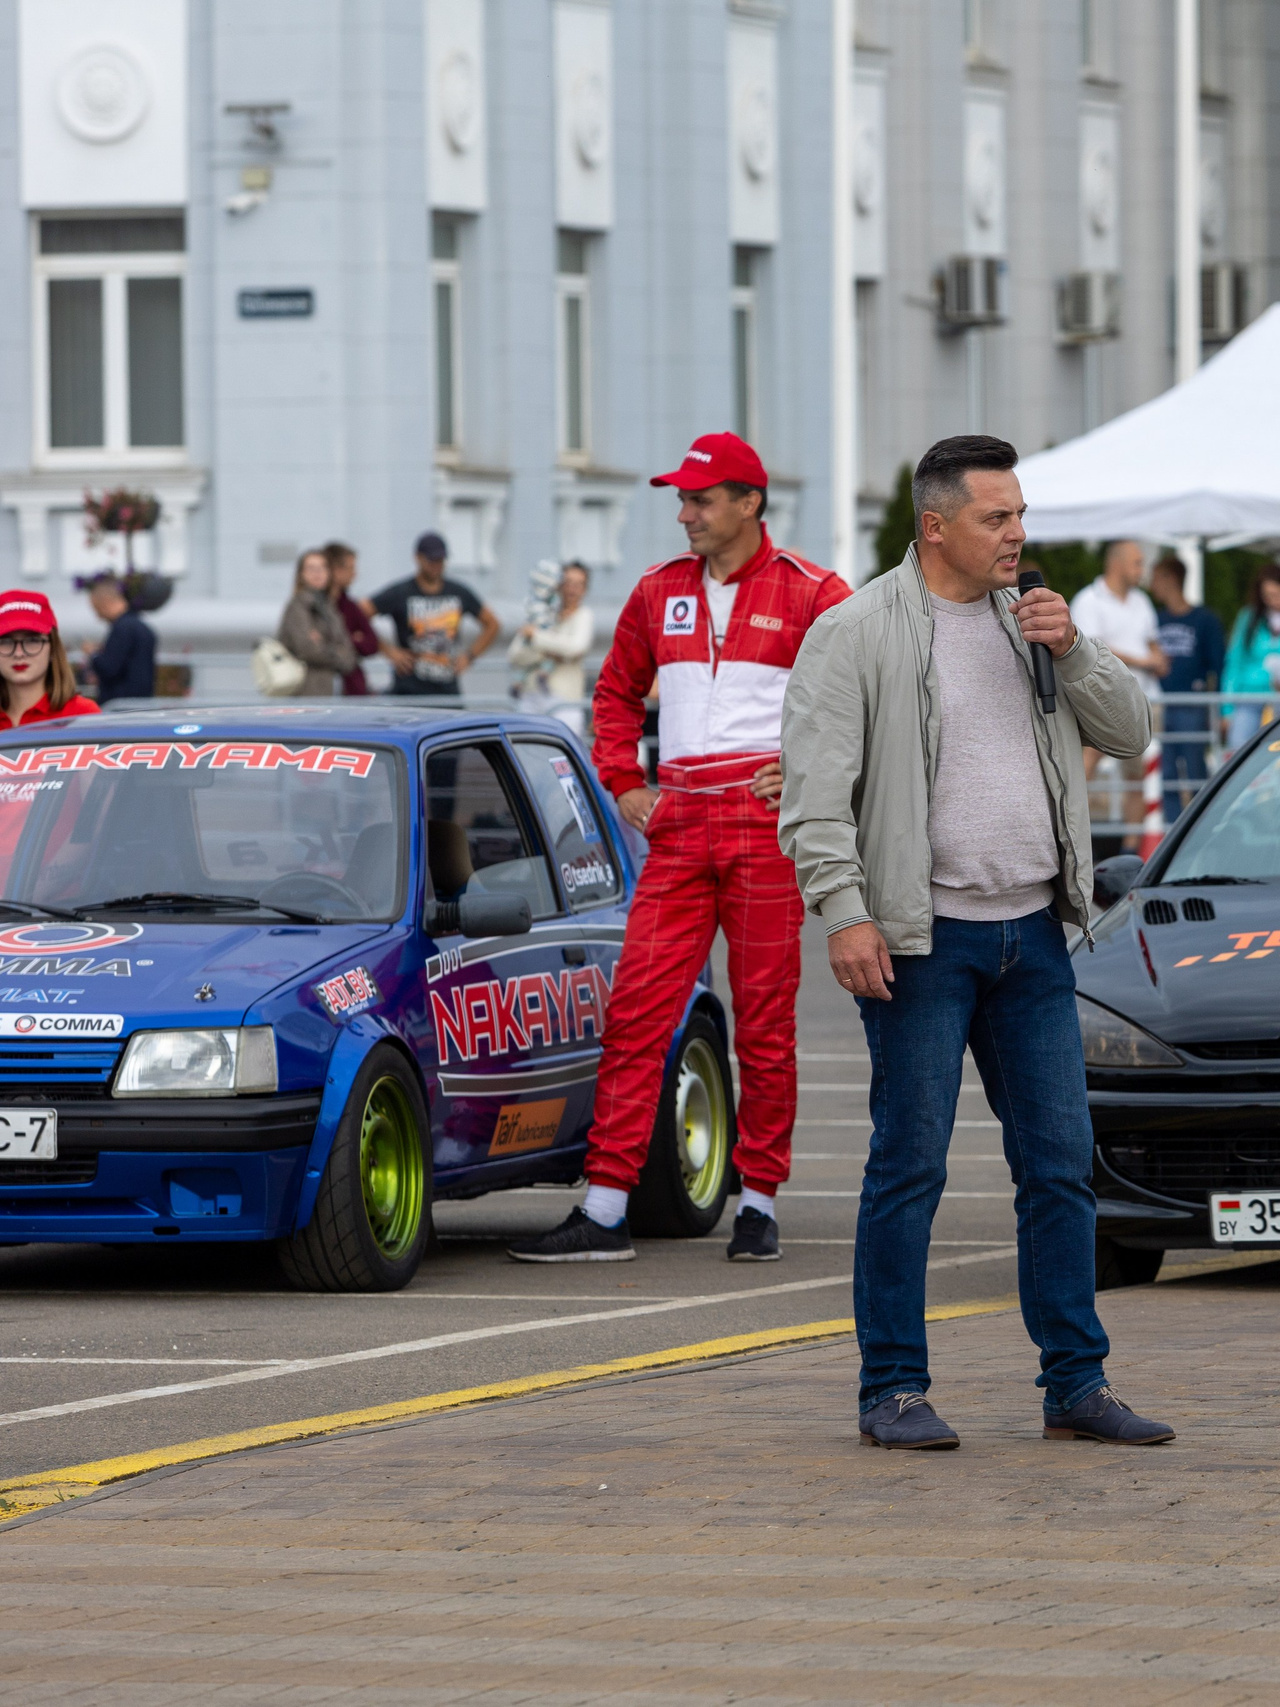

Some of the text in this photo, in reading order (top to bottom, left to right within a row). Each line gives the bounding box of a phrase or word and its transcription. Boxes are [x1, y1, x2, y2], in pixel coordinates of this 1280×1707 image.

[666, 622, 692, 631] COMMA
[0, 741, 376, 778] NAKAYAMA
[17, 780, 64, 798] parts
[321, 966, 373, 1015] ADT.BY
[40, 1018, 116, 1031] COMMA
[1219, 1221, 1238, 1236] BY
